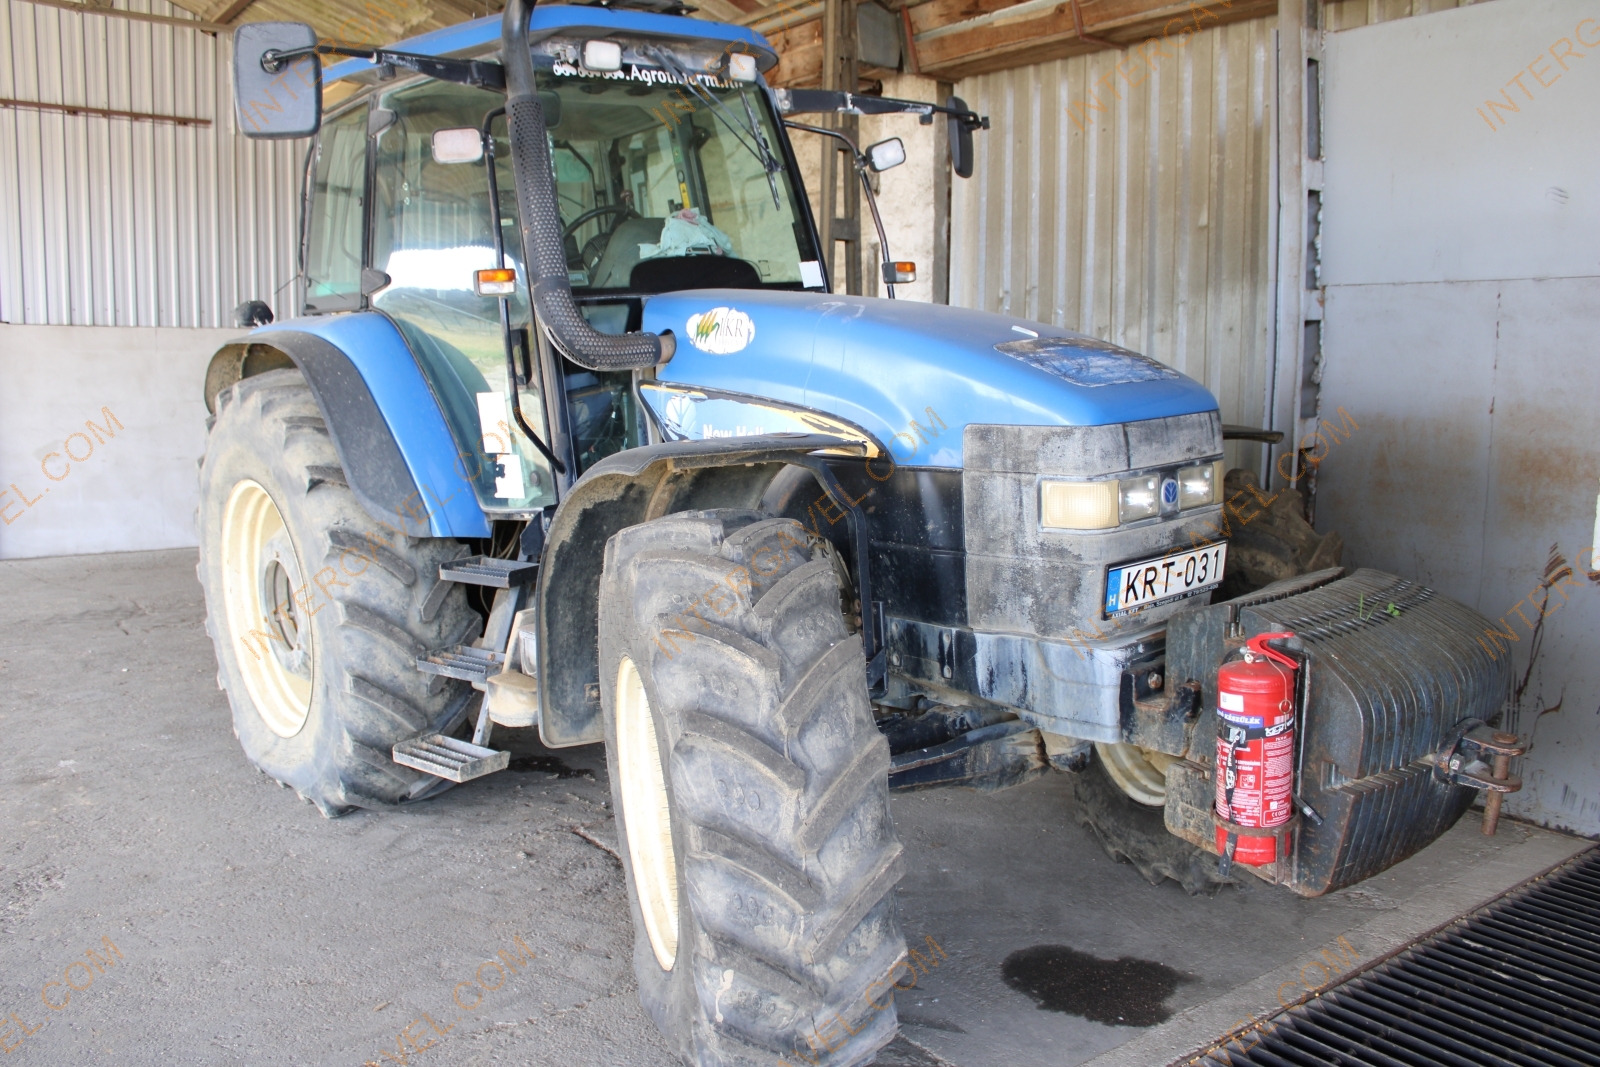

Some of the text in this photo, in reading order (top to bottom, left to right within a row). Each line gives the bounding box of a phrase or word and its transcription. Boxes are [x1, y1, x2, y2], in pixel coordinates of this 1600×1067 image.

[703, 424, 732, 439] New
[1125, 549, 1219, 604] KRT-031
[1108, 594, 1117, 607] H
